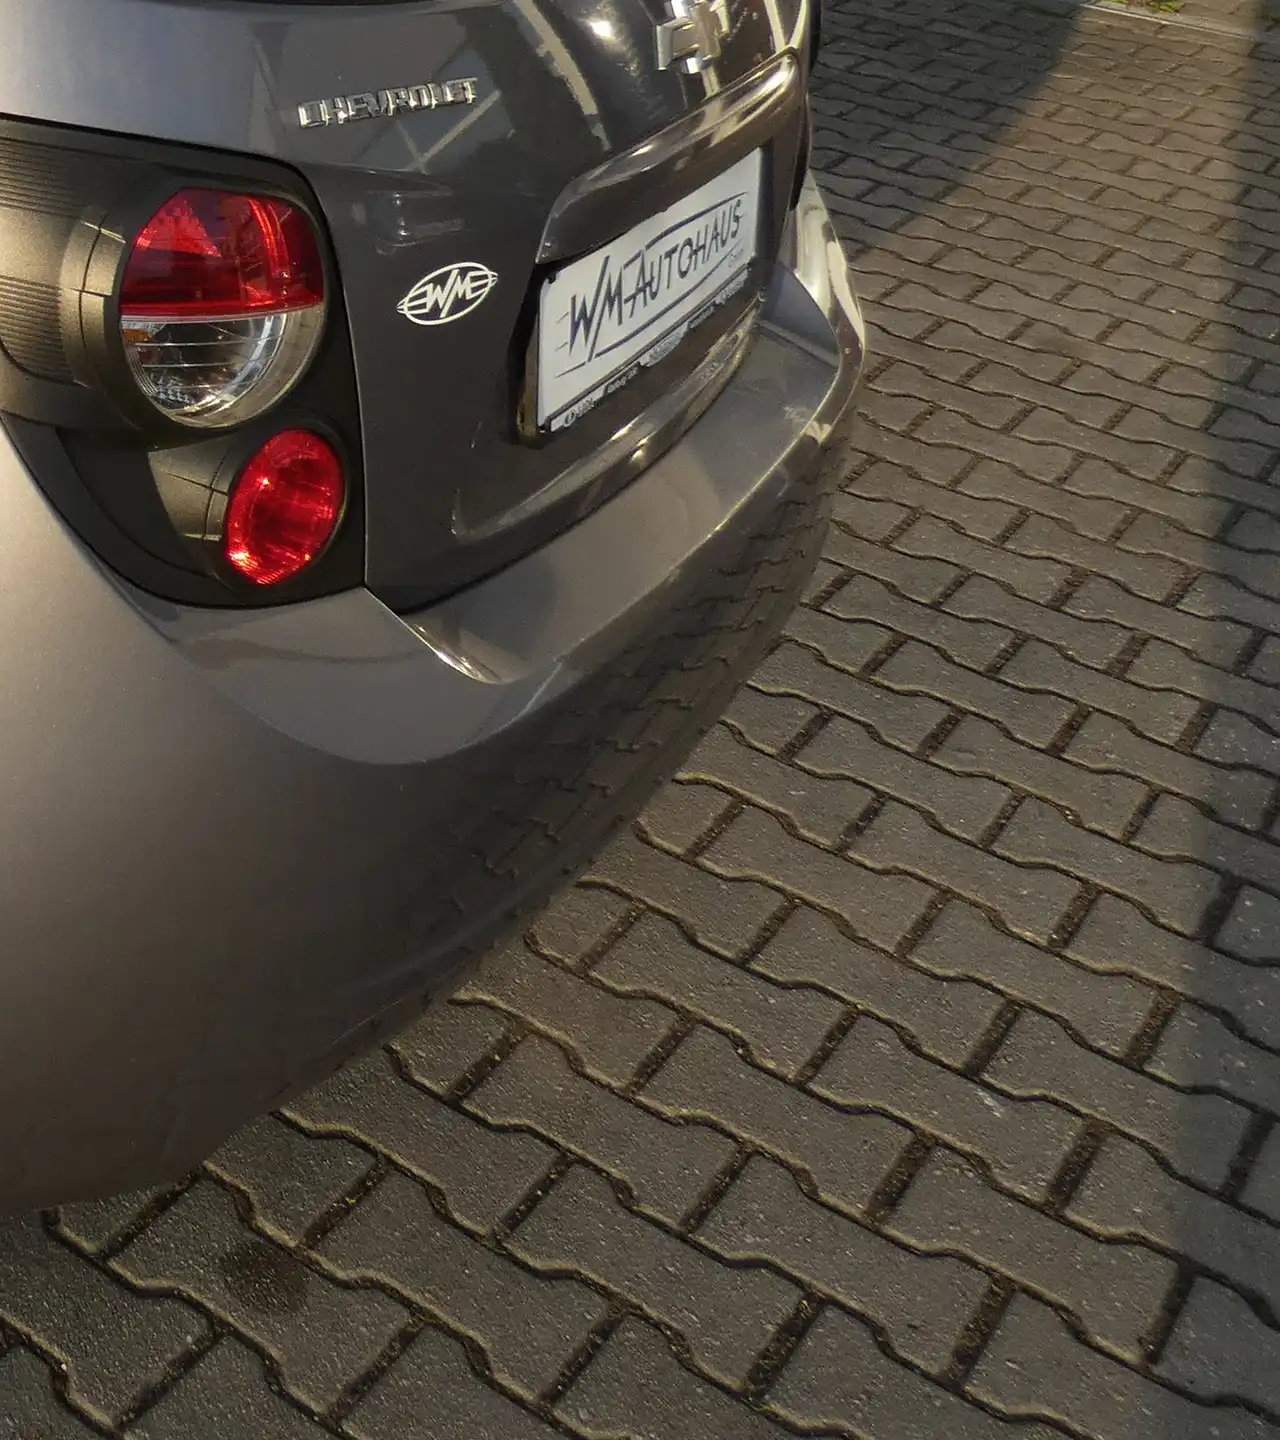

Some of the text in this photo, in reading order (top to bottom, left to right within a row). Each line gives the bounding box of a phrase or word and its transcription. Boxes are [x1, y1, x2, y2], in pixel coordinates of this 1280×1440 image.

[297, 77, 479, 128] CHEVROLET
[568, 198, 744, 363] WM AUTOHAUS
